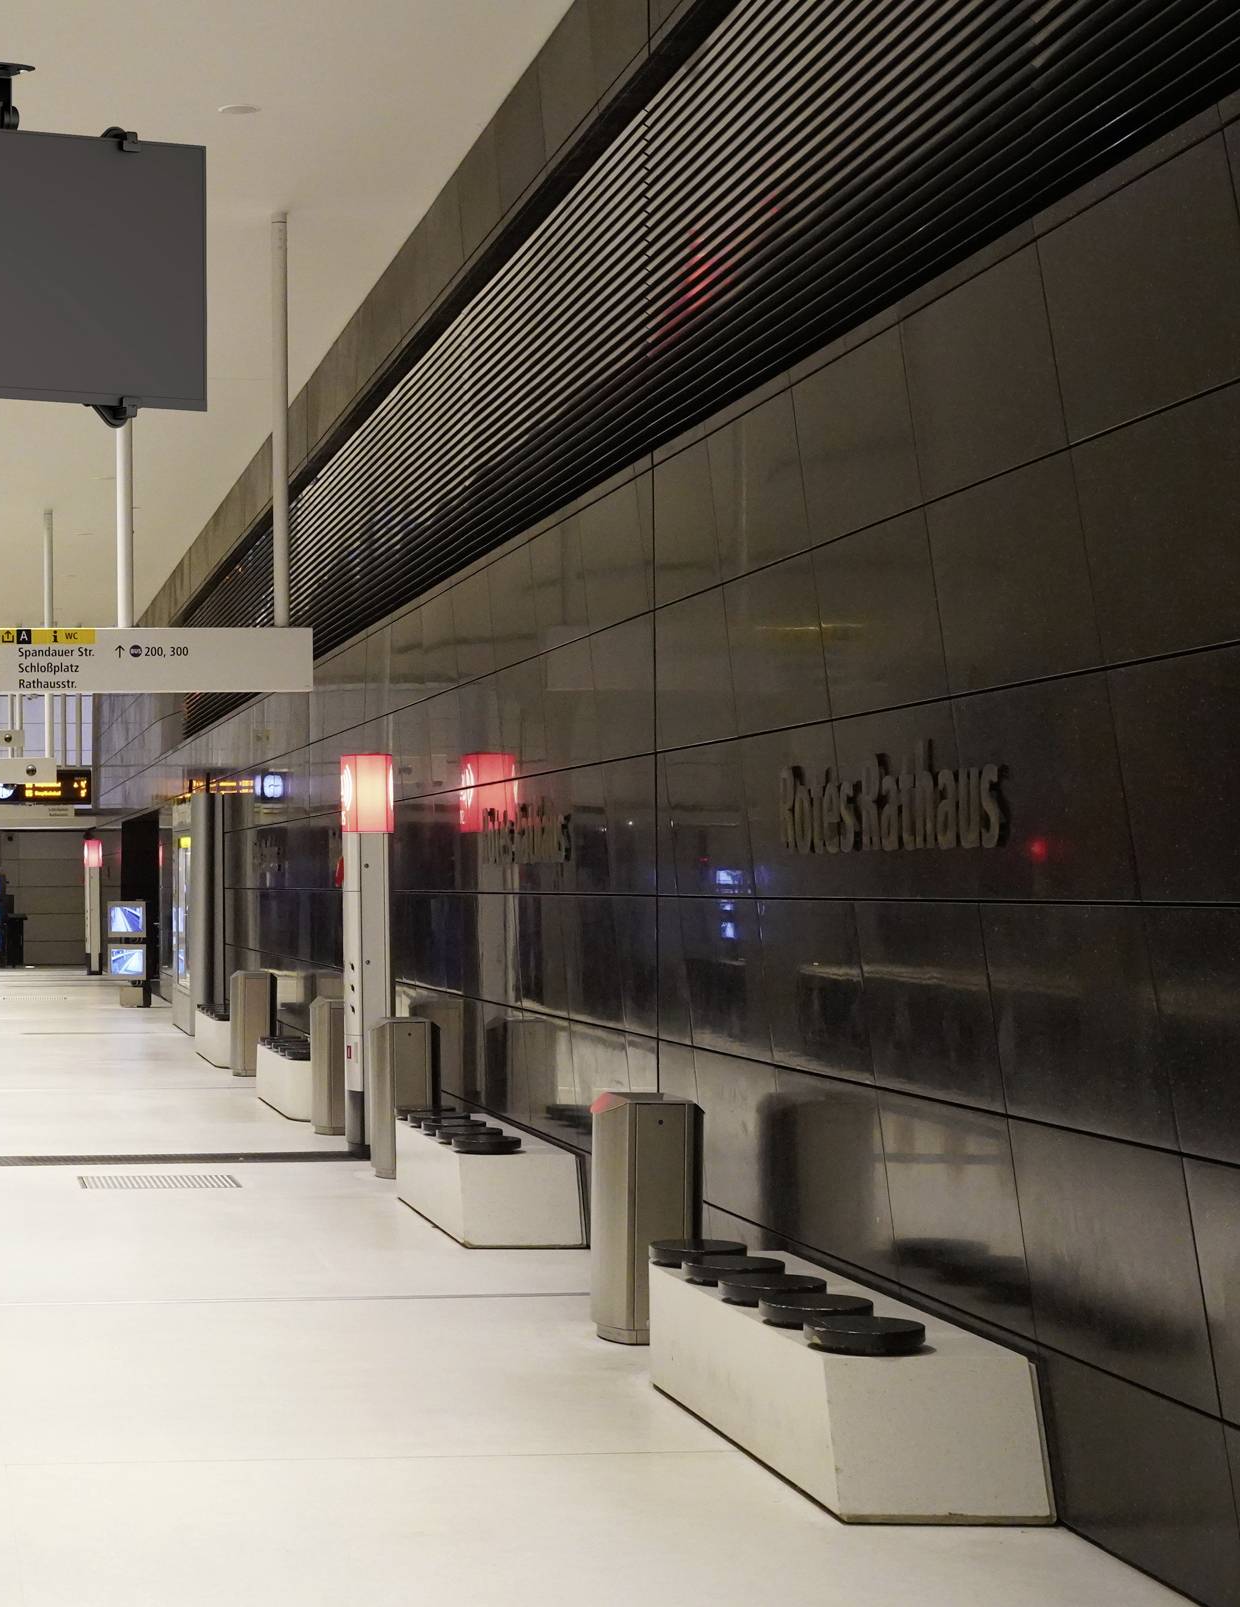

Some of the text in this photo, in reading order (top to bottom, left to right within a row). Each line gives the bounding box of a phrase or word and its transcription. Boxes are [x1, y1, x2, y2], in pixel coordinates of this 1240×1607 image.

[20, 631, 28, 641] A
[65, 632, 78, 640] WC
[18, 647, 95, 660] Spandauer Str.
[144, 646, 166, 658] 200,
[169, 646, 189, 657] 300
[18, 662, 80, 675] Schloßplatz
[18, 678, 77, 689] Rathausstr.
[779, 738, 1001, 854] Rotes Rathaus
